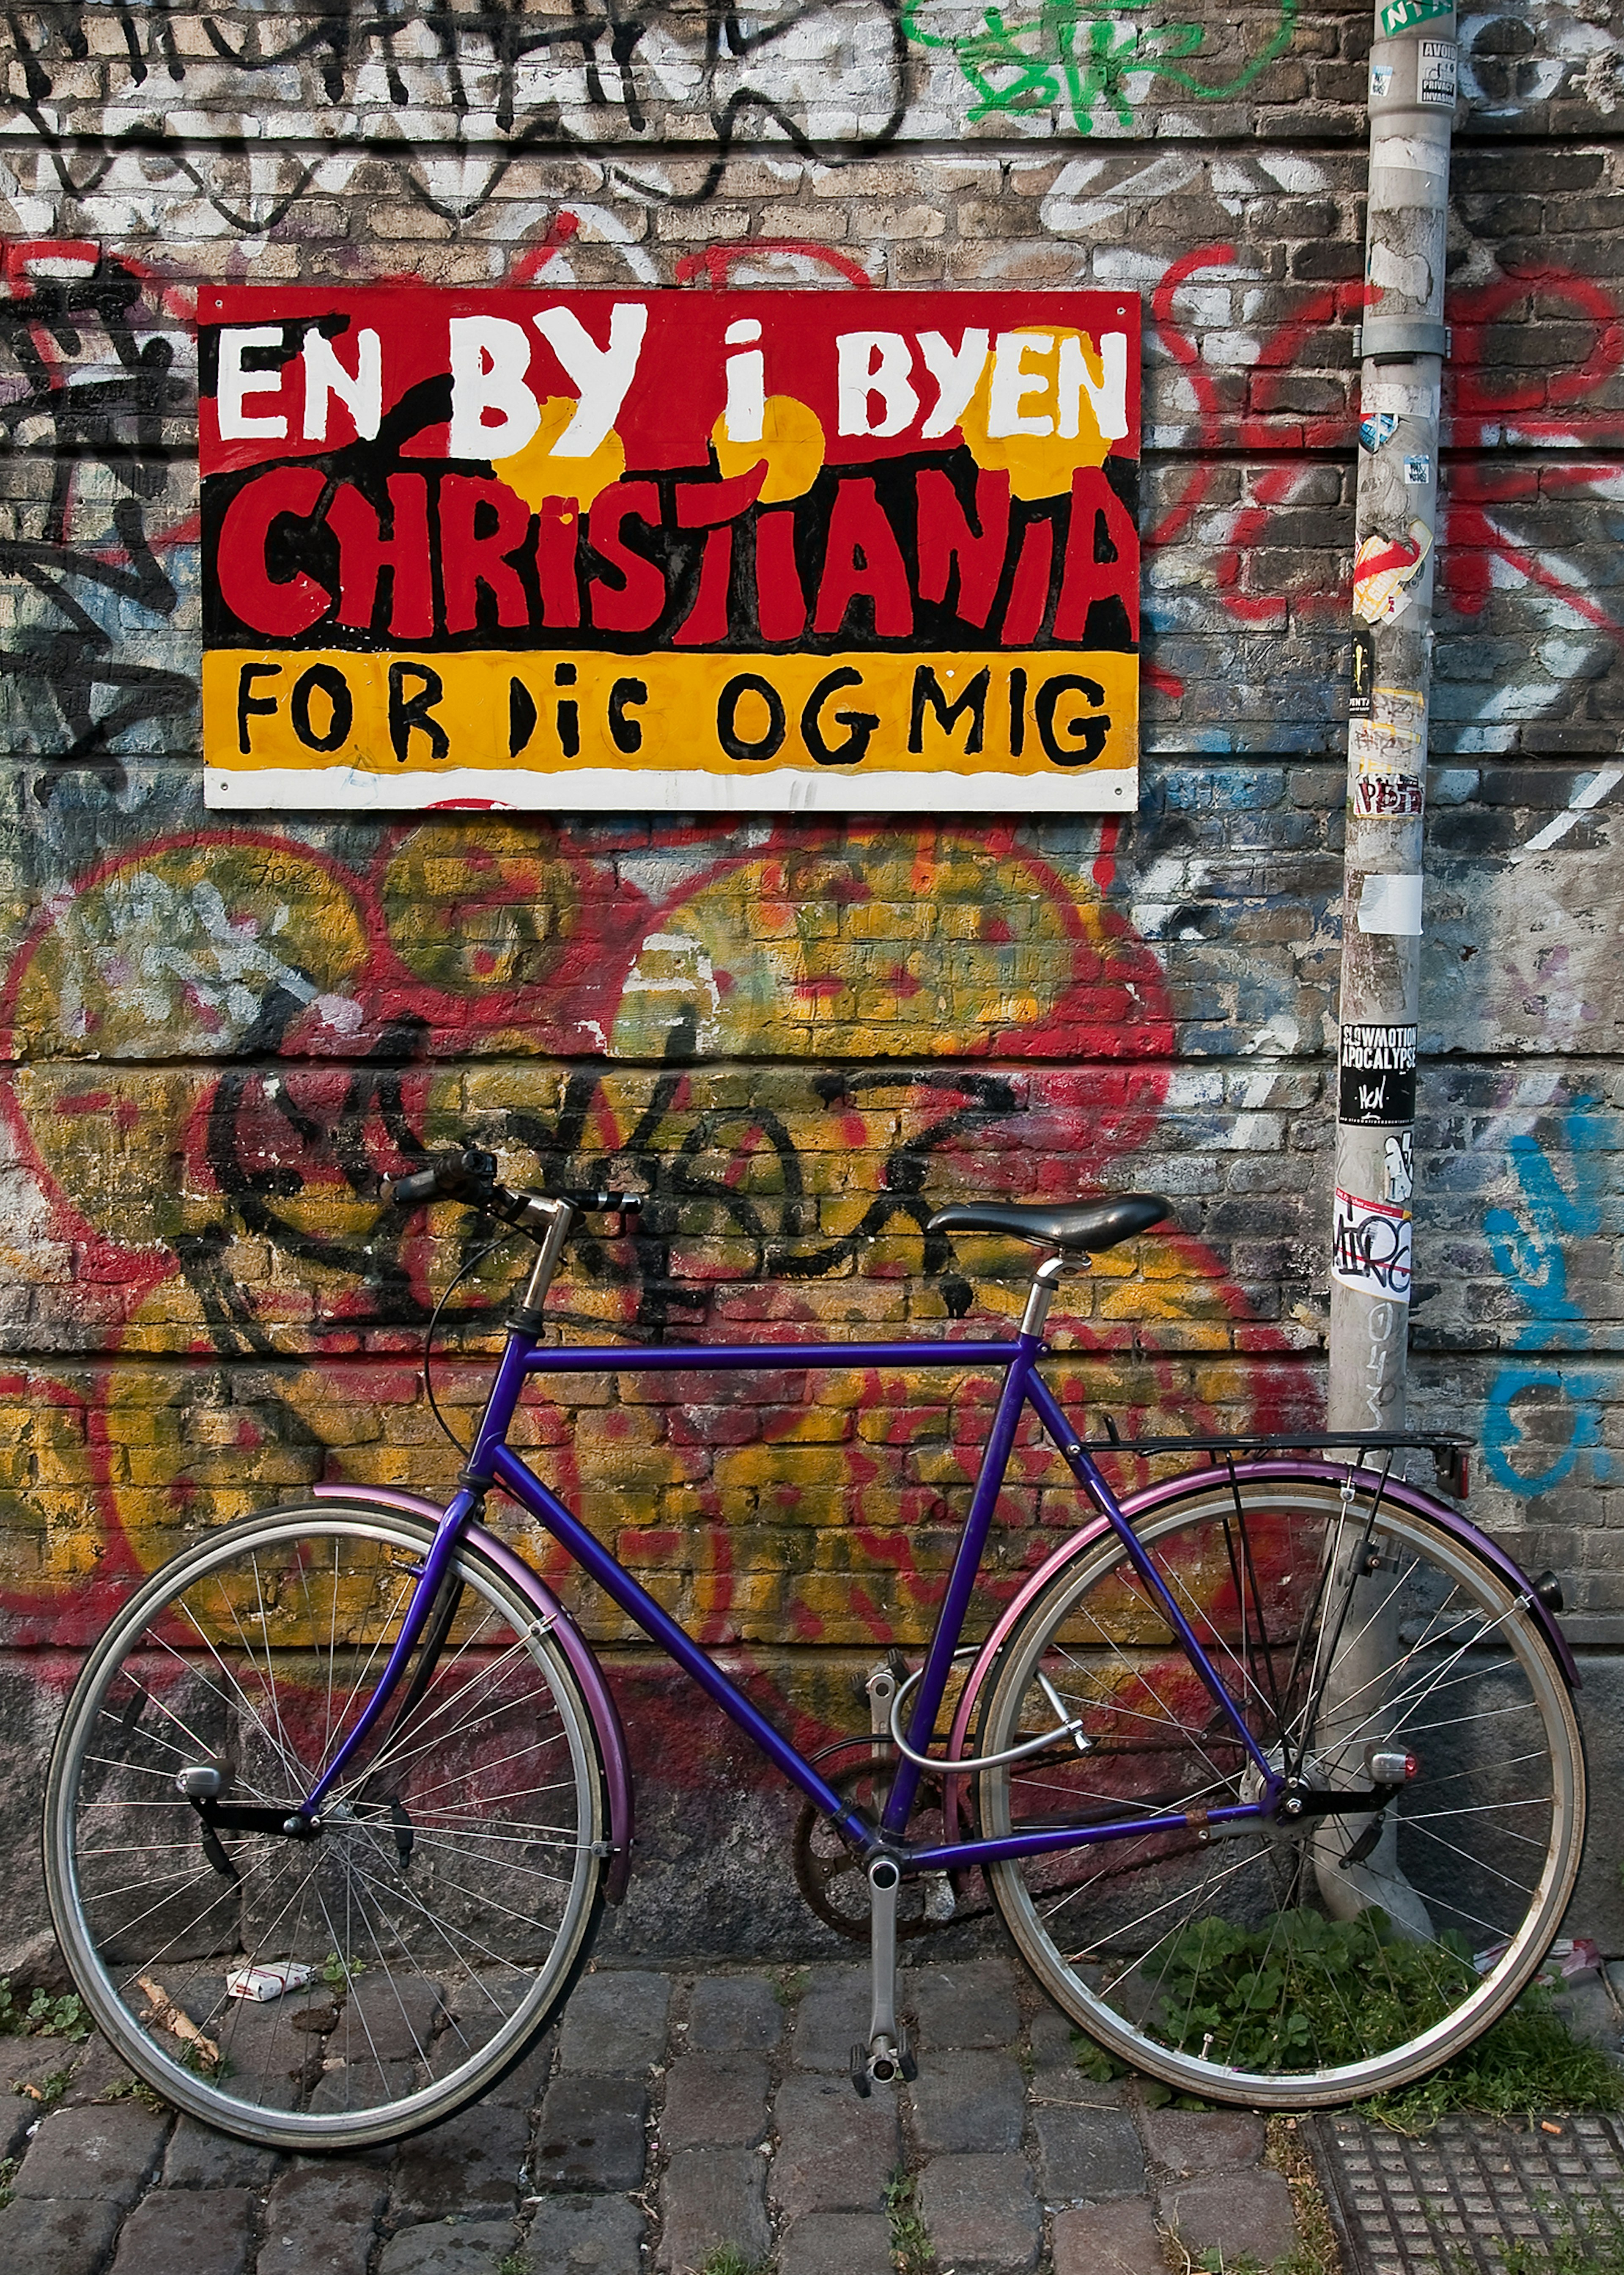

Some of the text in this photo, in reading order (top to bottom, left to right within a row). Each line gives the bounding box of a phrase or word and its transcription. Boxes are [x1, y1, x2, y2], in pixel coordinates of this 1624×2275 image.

[1424, 44, 1456, 60] AVOID
[1424, 80, 1453, 92] PRIVACY
[217, 327, 382, 441] EN
[448, 302, 648, 461] BY
[836, 327, 1128, 440] BYEN
[217, 466, 1139, 646] CHRISTIANIA
[238, 662, 450, 761] FOR
[716, 666, 881, 765] OG
[908, 665, 1111, 767] MIG
[1343, 1026, 1416, 1047] SLOWMOTION
[1342, 1045, 1416, 1069] APOCALYPSE
